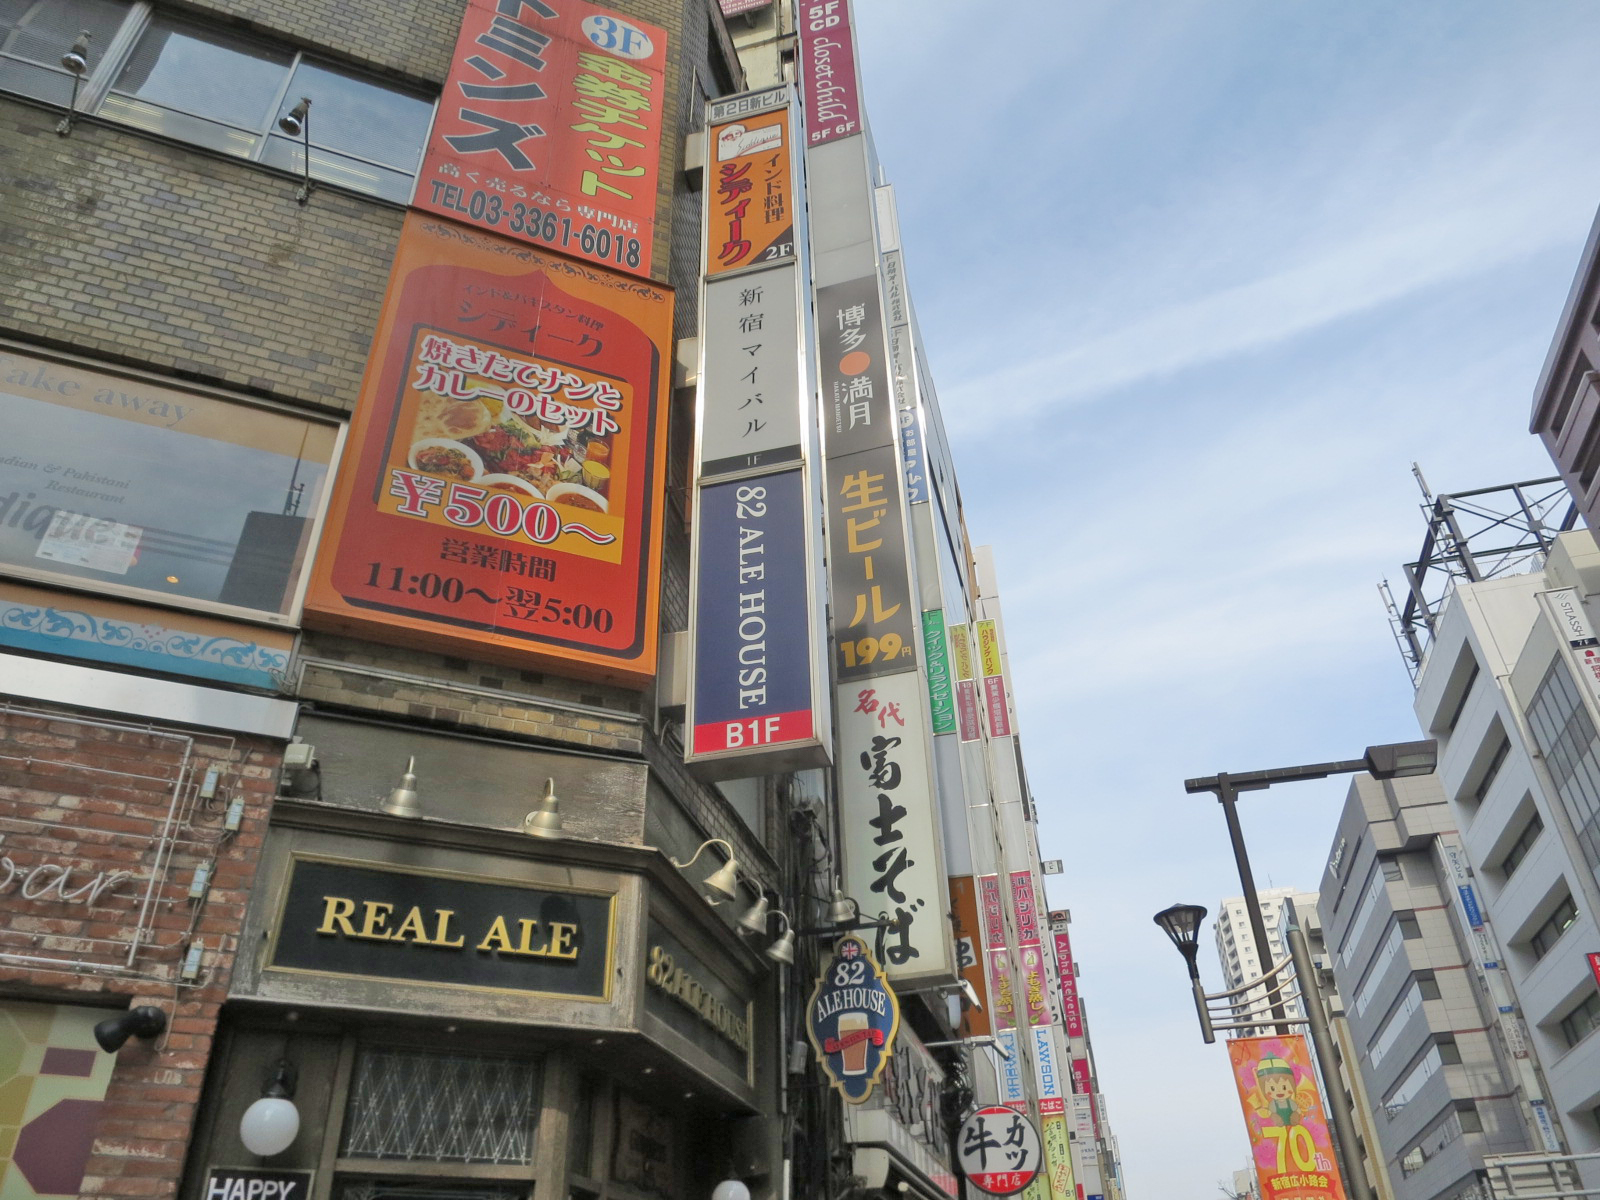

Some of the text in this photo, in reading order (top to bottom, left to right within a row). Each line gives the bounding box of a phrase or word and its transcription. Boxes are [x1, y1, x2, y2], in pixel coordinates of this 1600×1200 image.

[808, 1, 839, 19] 5F
[809, 15, 840, 31] CD
[590, 16, 648, 55] 3F
[713, 91, 785, 118] 第2日新ビル
[570, 51, 652, 200] 金券チケット
[811, 121, 856, 141] 5F 6F
[763, 153, 785, 224] インド料理
[717, 162, 753, 267] シディーク
[765, 242, 792, 261] 2F
[457, 300, 604, 358] シディーク
[420, 335, 624, 412] 焼きたてナンと
[737, 286, 767, 438] 新宿マイバル
[836, 302, 873, 431] 博多 満月
[92, 387, 195, 428] away
[412, 365, 622, 438] カレーのセット
[62, 466, 131, 491] Pakistani
[747, 455, 763, 467] 1F
[44, 478, 126, 505] Restaurant
[440, 537, 557, 582] 営業時間
[840, 470, 902, 629] 生ビール
[736, 486, 767, 710] 82 ALE HOUSE
[840, 632, 912, 669] 199円
[987, 678, 999, 686] 6F
[853, 688, 905, 729] 名代
[726, 716, 780, 749] B1F
[860, 735, 925, 967] 富士そば
[316, 896, 579, 960] REAL ALE
[834, 961, 866, 987] 82
[1058, 941, 1070, 975] Alpha
[1063, 980, 1078, 1030] Reverse
[1036, 1030, 1055, 1097] LAWSON
[1040, 1101, 1063, 1110] たばこ
[963, 1114, 1029, 1171] 牛カツ
[206, 1177, 296, 1200] HAPPY
[983, 1173, 1021, 1188] 専門店
[1271, 1174, 1329, 1191] 新宿広小路会
